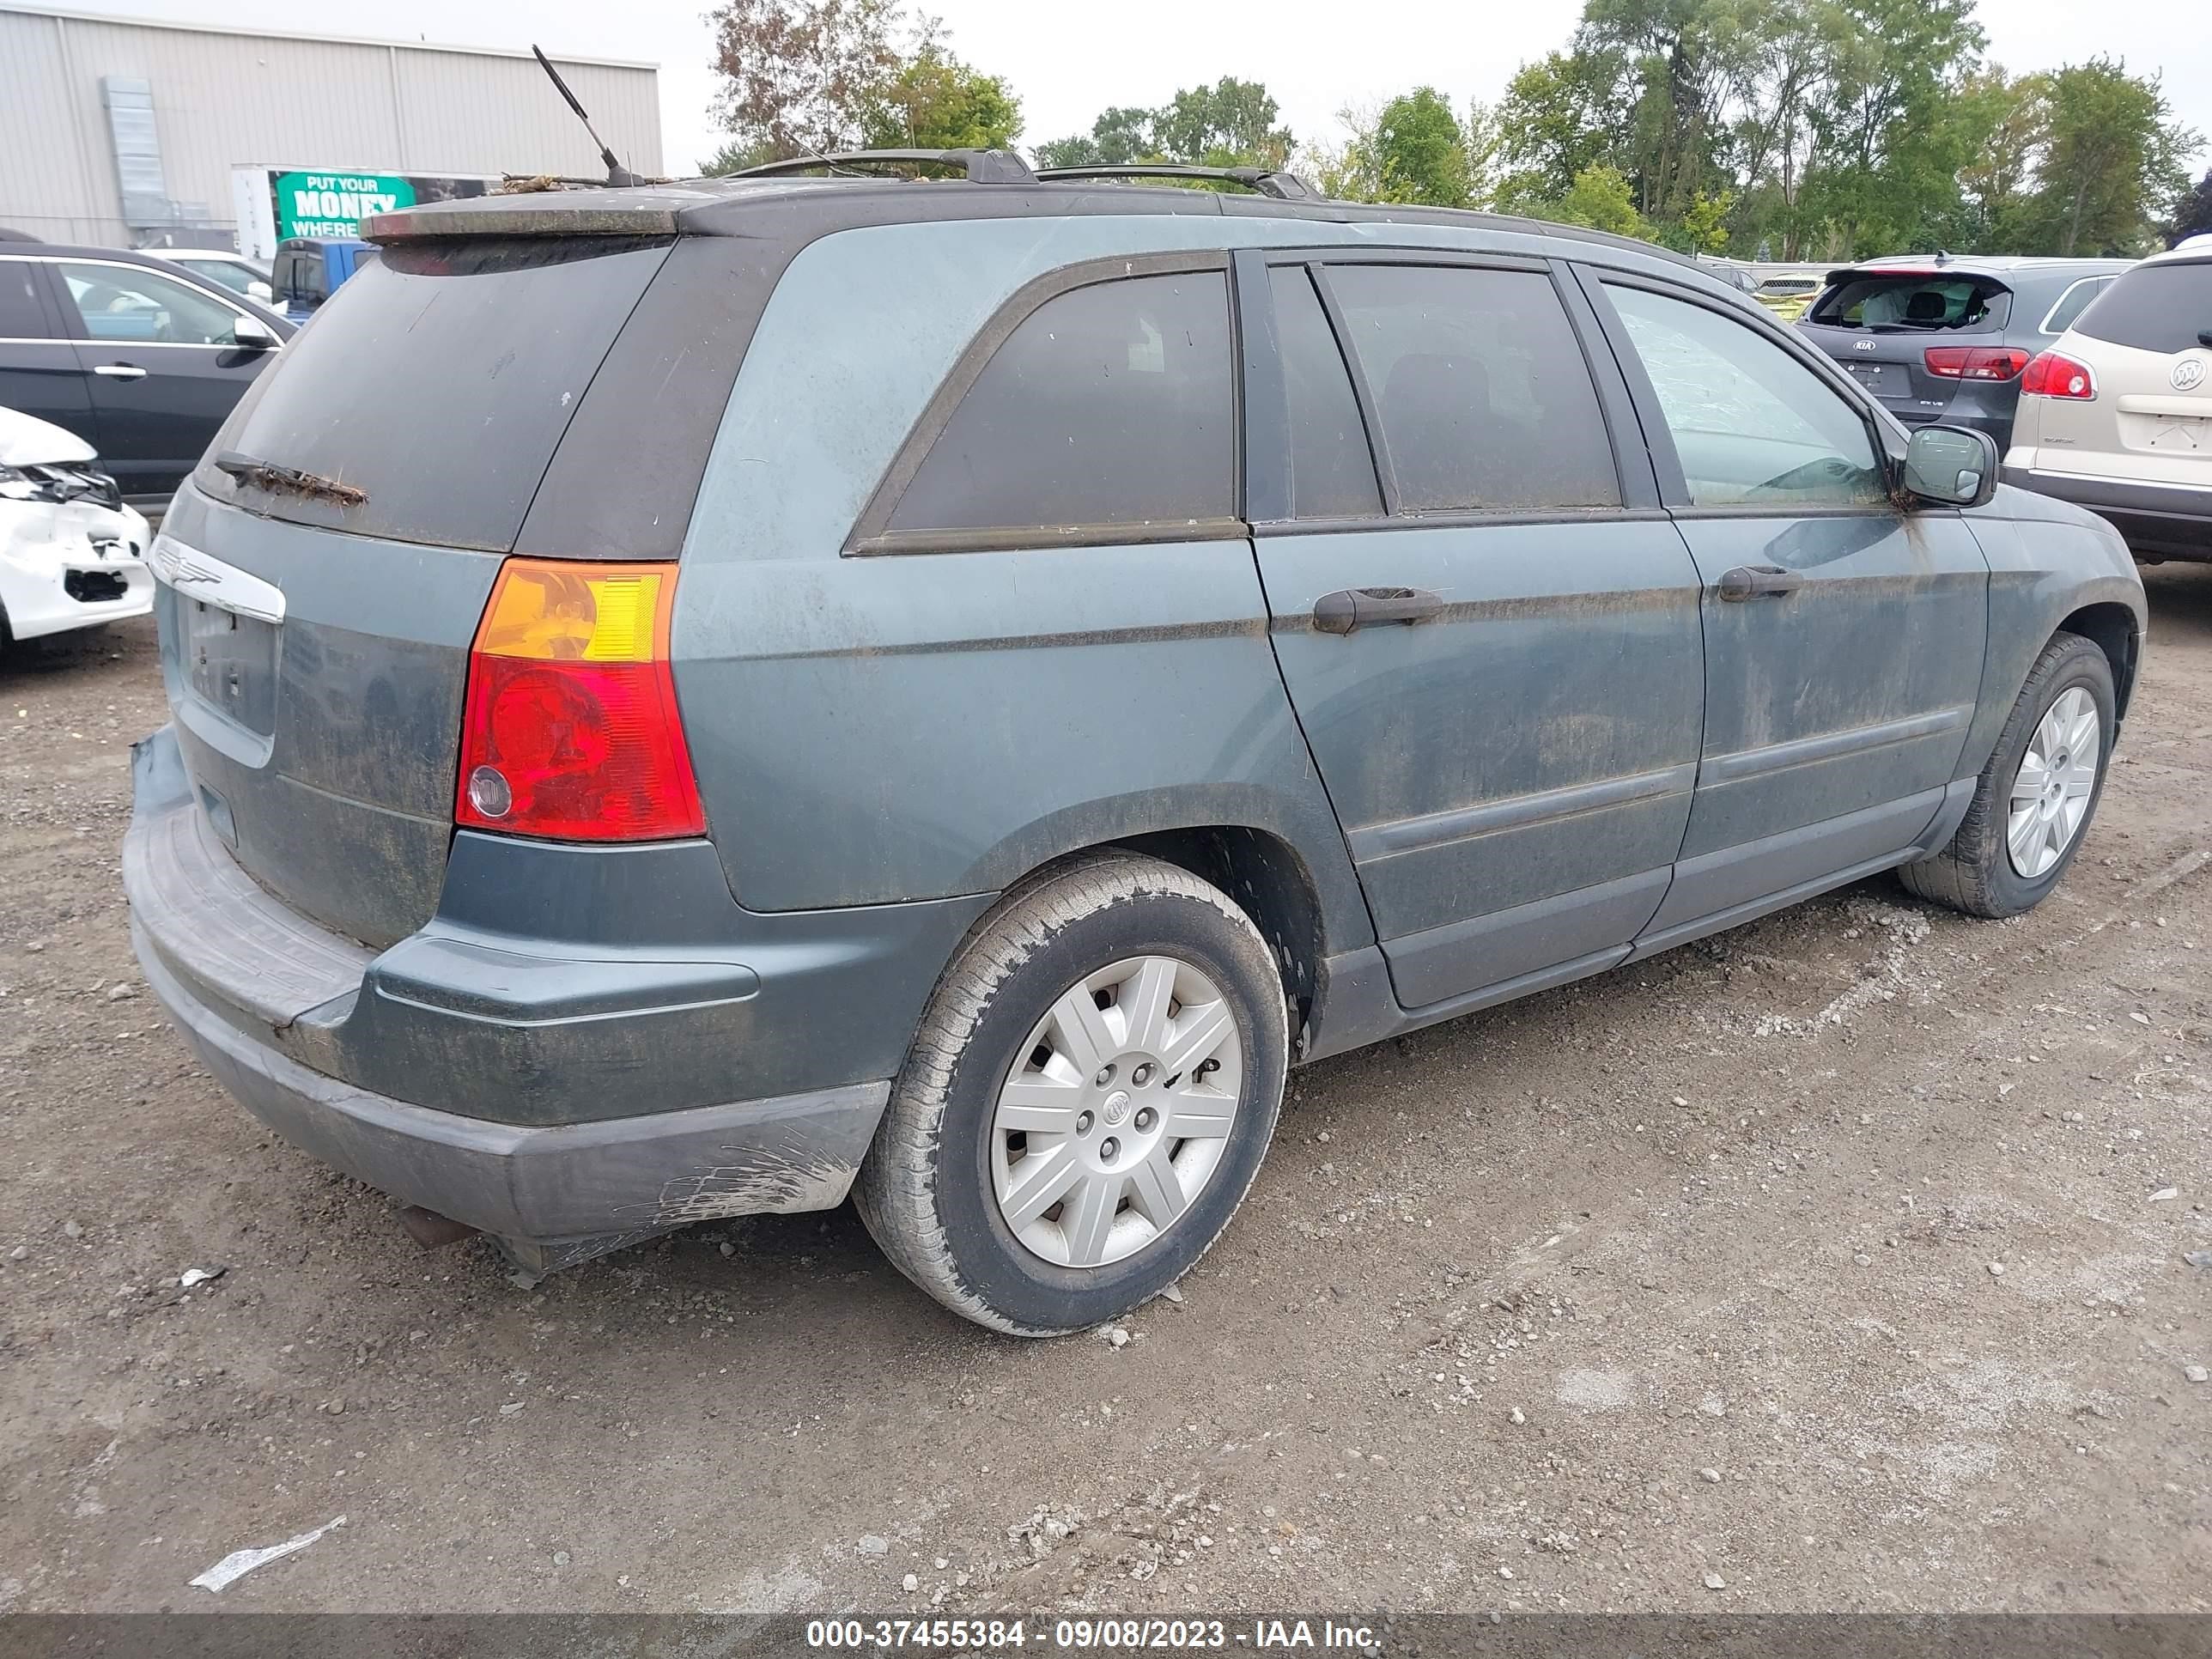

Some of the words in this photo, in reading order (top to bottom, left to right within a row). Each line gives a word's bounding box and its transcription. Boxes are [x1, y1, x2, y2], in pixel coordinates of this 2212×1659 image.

[307, 176, 337, 190] PUT
[337, 178, 378, 192] YOUR
[294, 190, 397, 219] MONEY
[291, 220, 358, 237] WHERE
[1855, 341, 1874, 350] KIA
